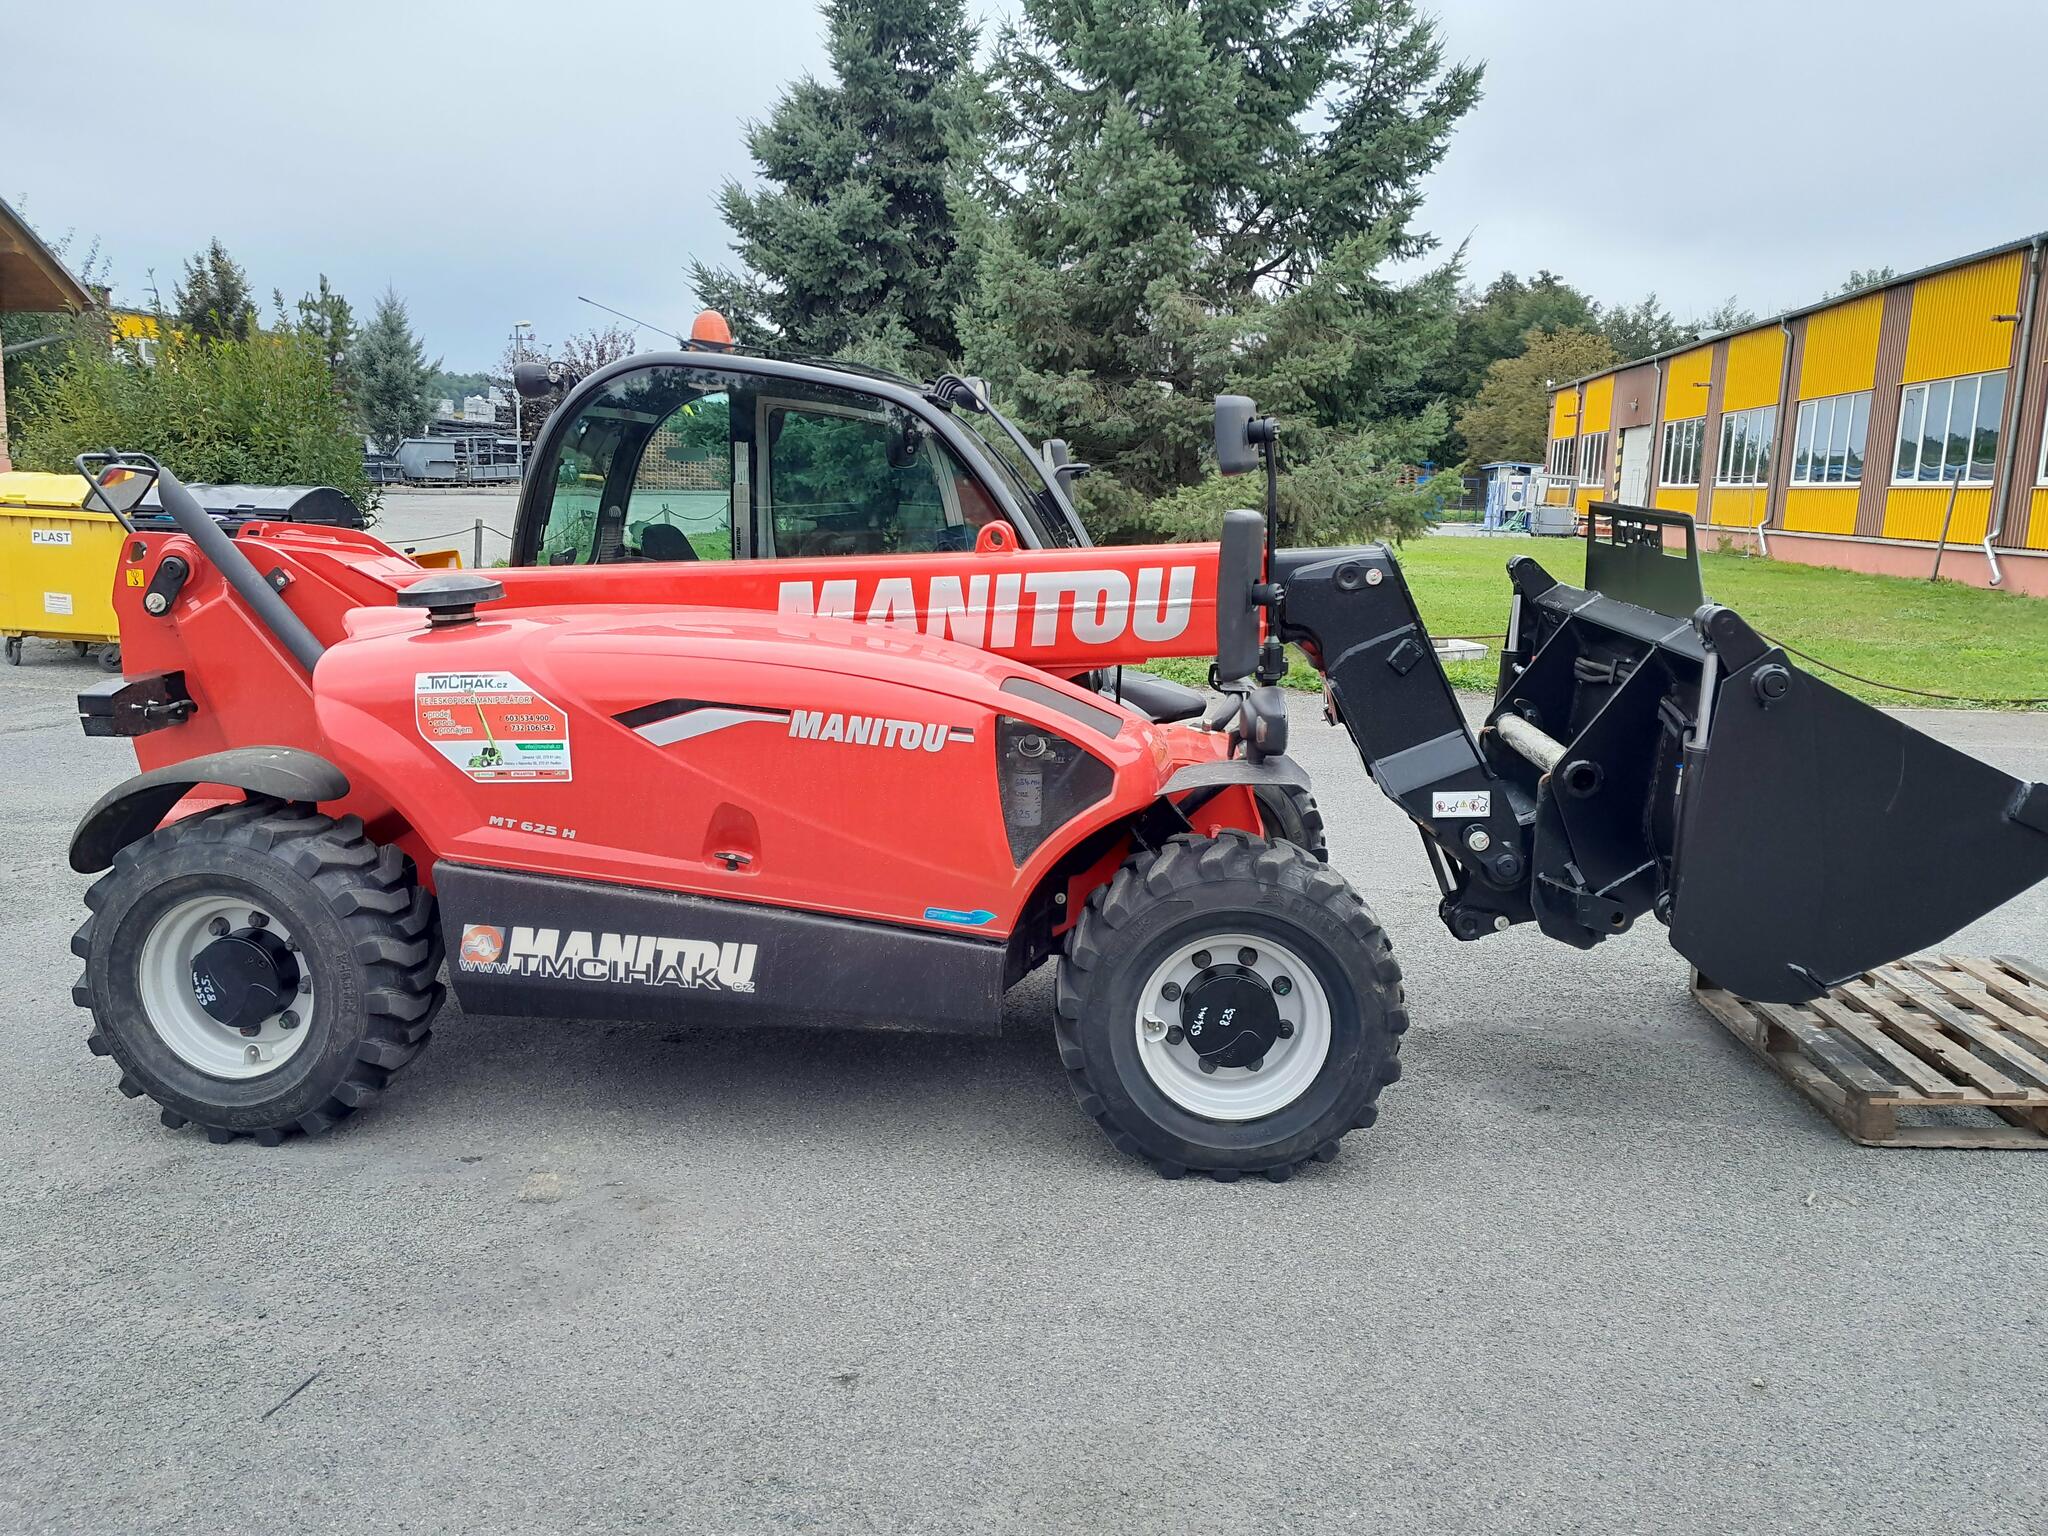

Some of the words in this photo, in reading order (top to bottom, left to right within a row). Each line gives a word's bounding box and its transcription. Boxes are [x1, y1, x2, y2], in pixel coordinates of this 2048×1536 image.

[33, 532, 70, 542] PLAST
[777, 566, 1196, 648] MANITOU
[788, 709, 948, 752] MANITOU
[488, 815, 517, 828] MT
[520, 821, 557, 836] 625
[562, 828, 577, 839] H
